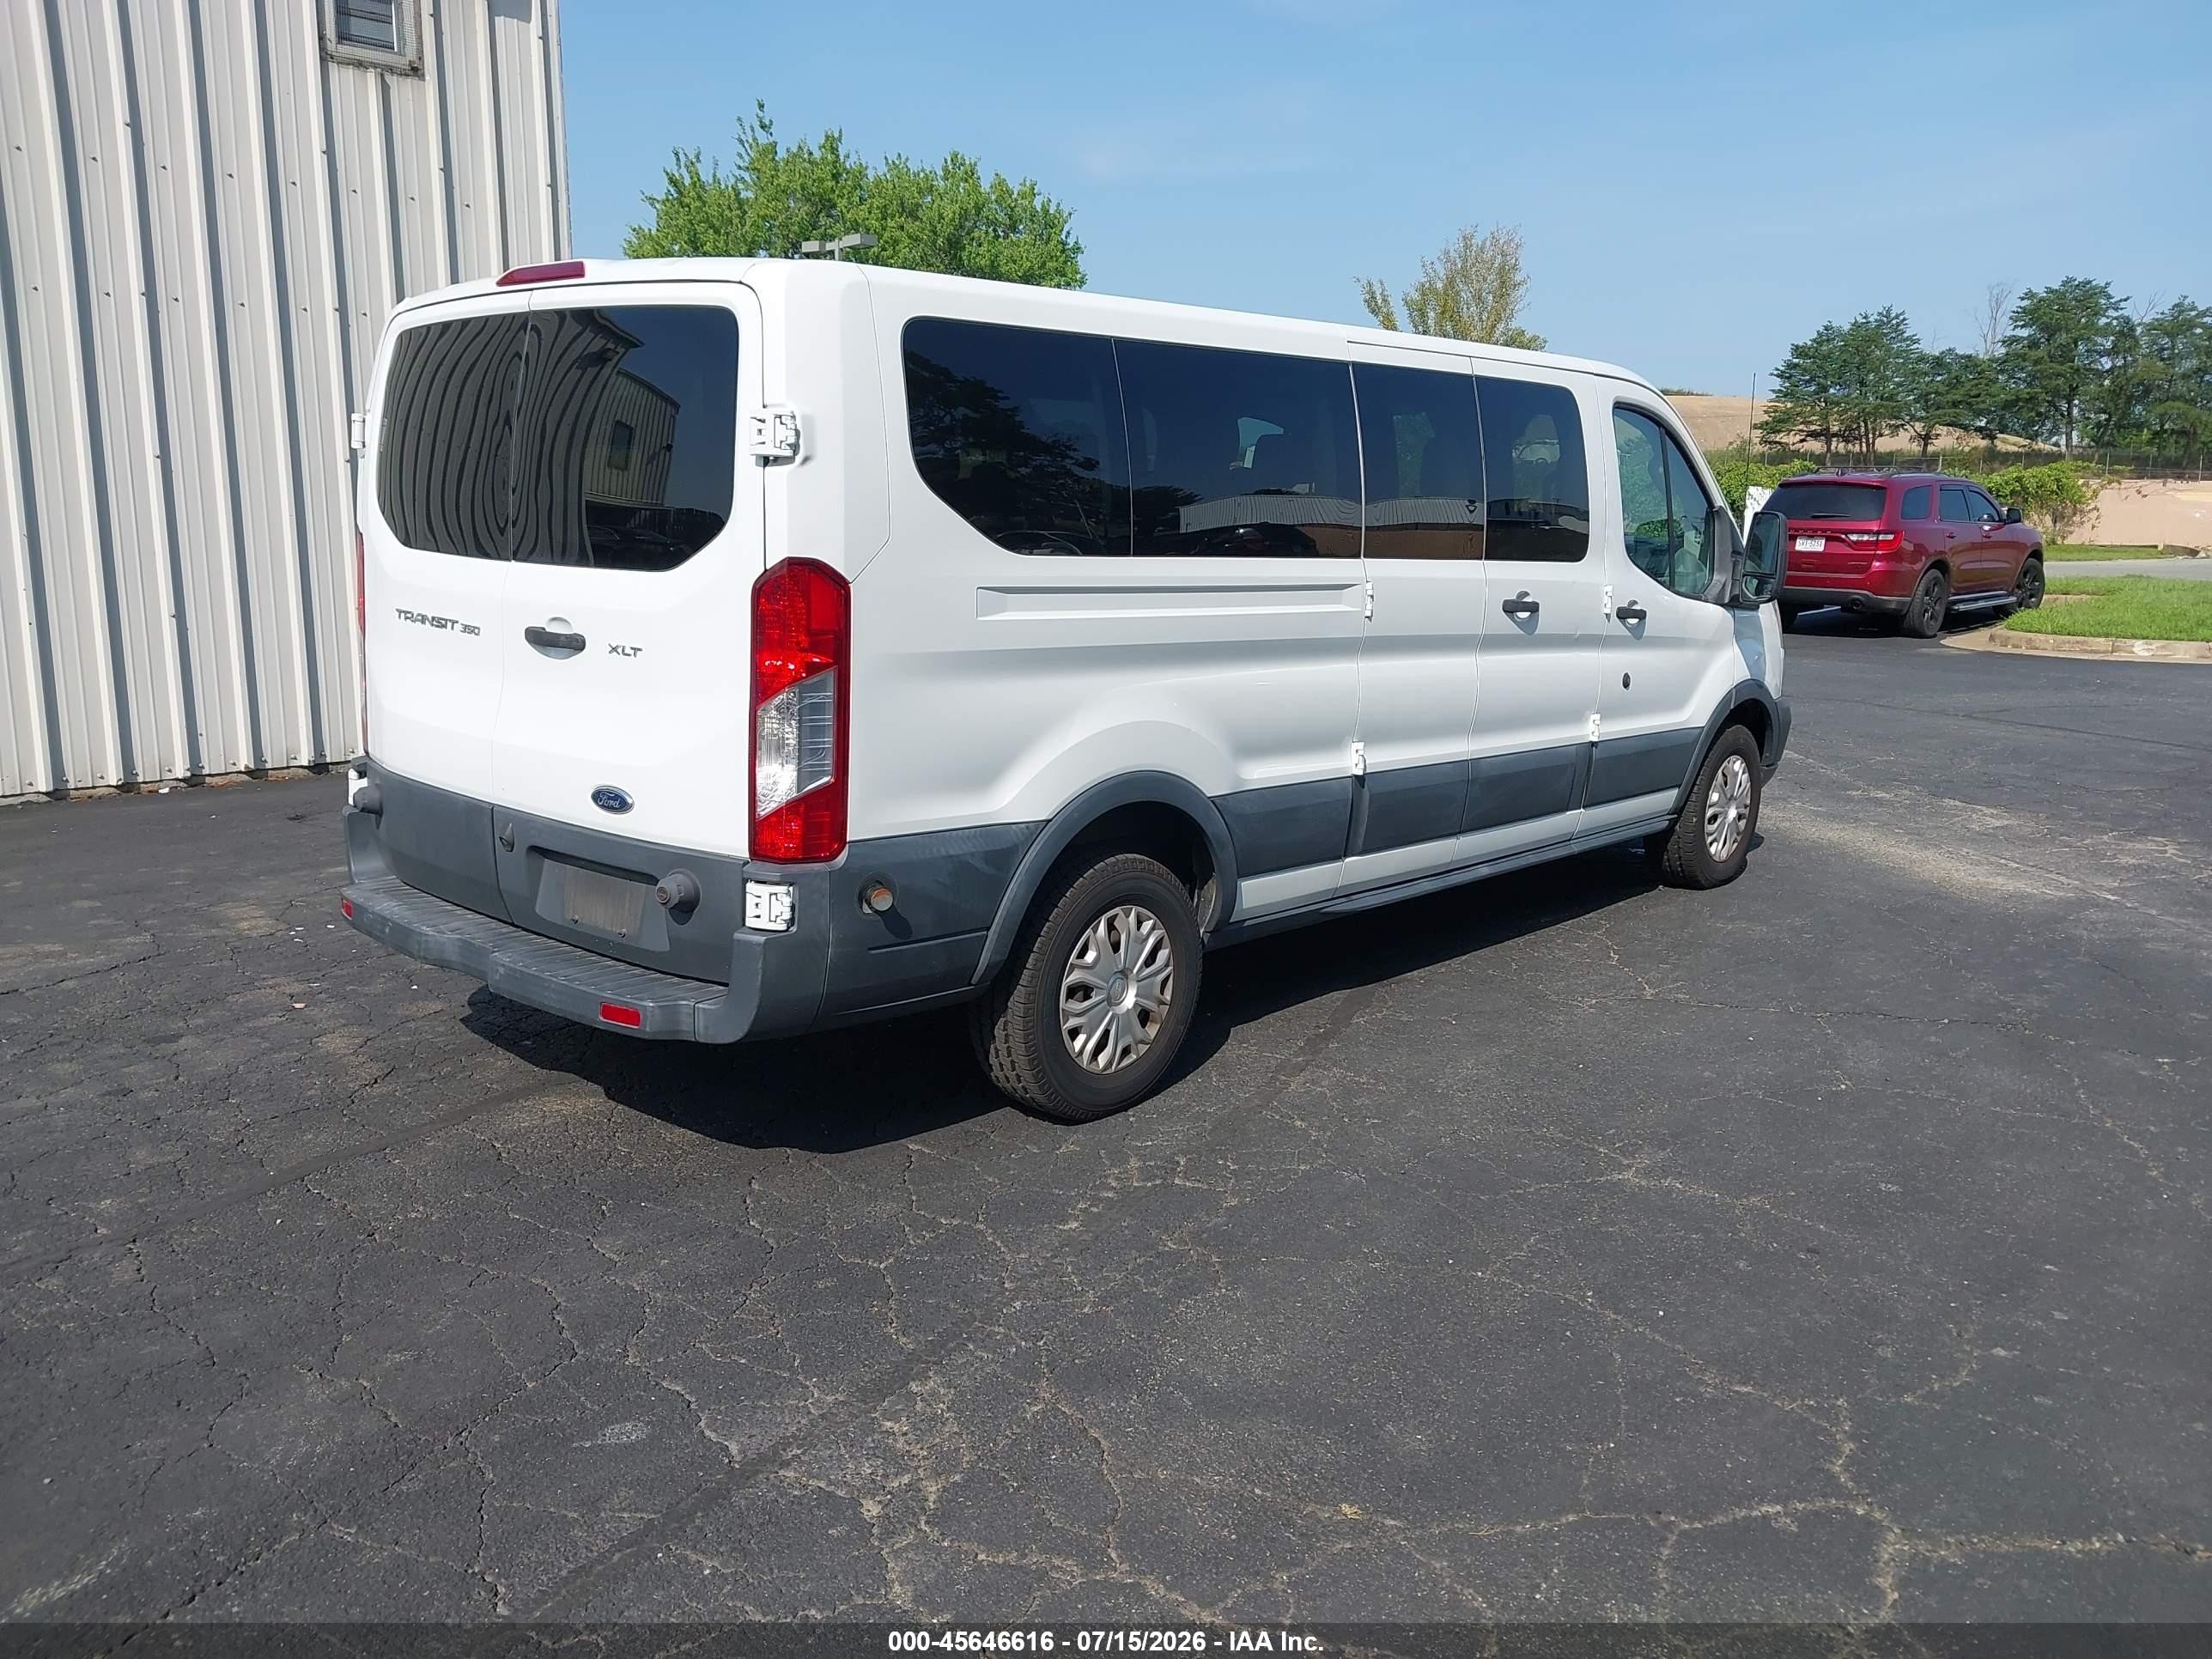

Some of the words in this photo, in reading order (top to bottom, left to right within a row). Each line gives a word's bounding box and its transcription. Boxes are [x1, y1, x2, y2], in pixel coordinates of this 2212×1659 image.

[395, 608, 459, 631] TRANSIT
[459, 623, 481, 636] 350
[608, 643, 643, 658] XLT
[597, 791, 622, 808] Ford
